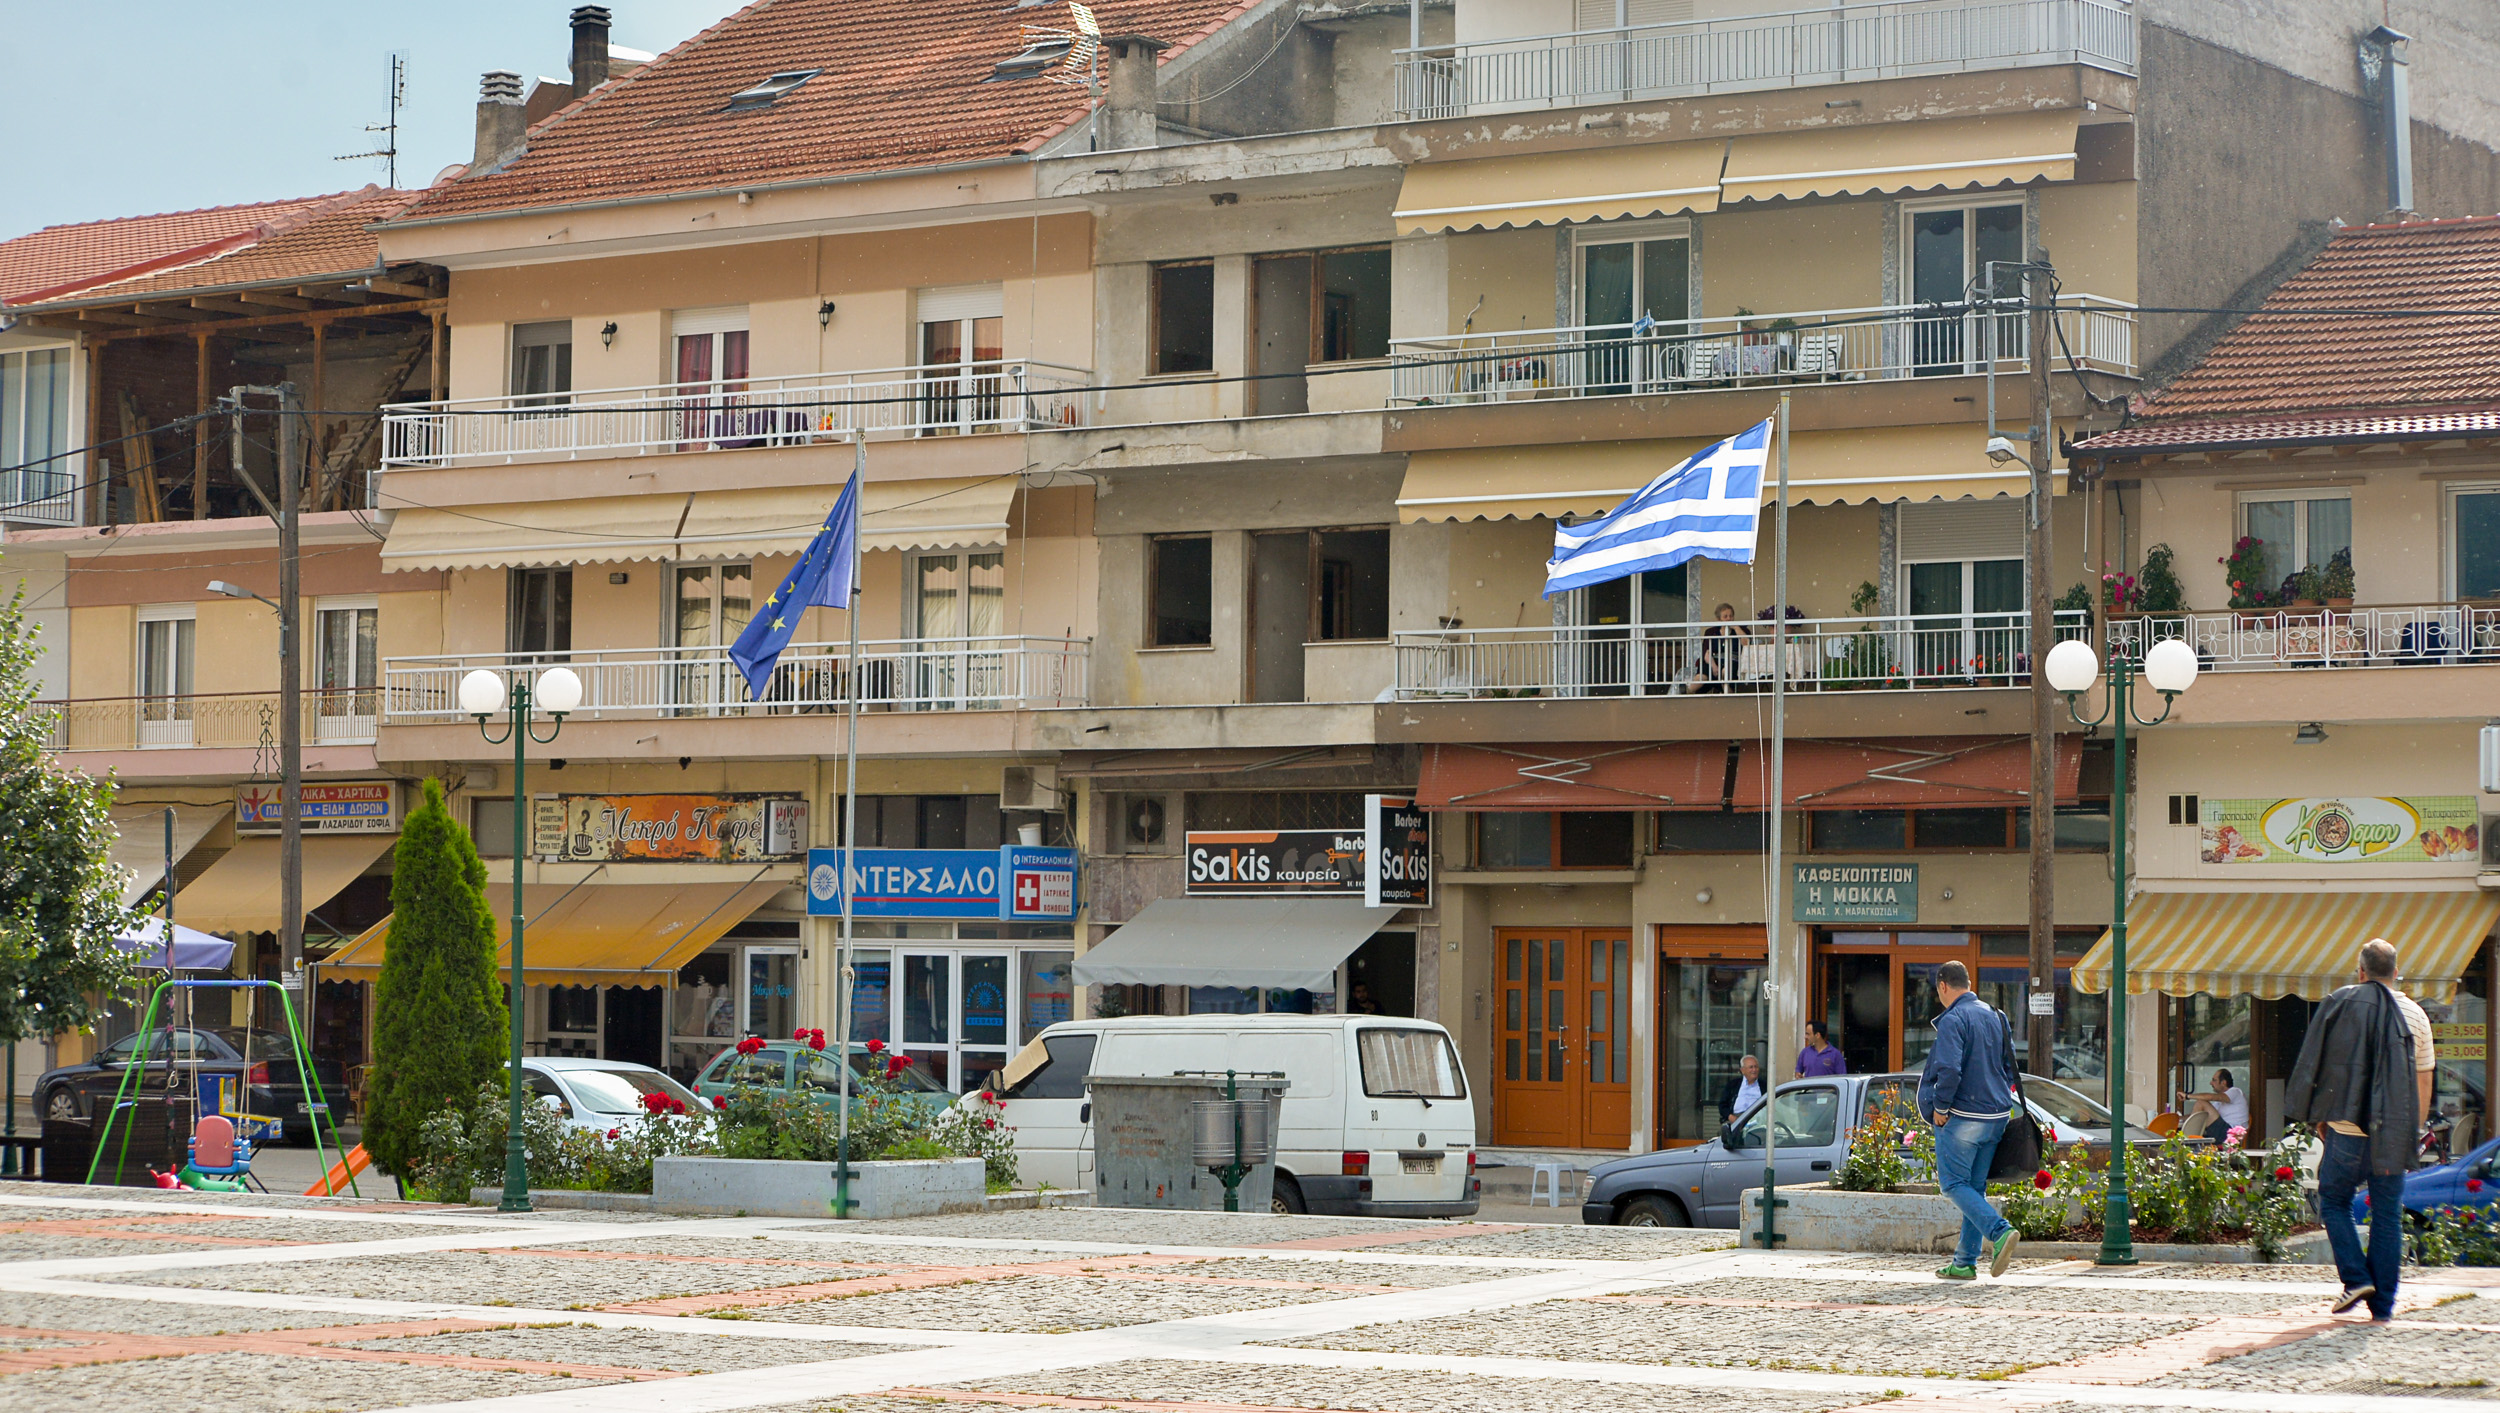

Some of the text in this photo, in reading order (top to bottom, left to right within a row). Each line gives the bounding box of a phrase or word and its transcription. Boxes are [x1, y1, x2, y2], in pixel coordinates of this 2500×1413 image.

[337, 787, 382, 799] ΧΑΡΤΙΚΑ
[265, 804, 313, 816] ΠΑΙΙΑ
[322, 803, 345, 815] ΕΙΔΗ
[349, 802, 383, 814] ΔΩΡΩΝ
[322, 818, 390, 829] ΛΑΖΑΡΙΔΟΥ ΣΟΦΙΑ
[1394, 813, 1422, 827] Barber
[594, 807, 680, 851] Μικρό
[1335, 836, 1365, 851] Barb
[1021, 855, 1073, 865] ΙΝΤΕΡΣΑΛΟΝΙΚΑ
[1191, 848, 1270, 882] Sakis
[1381, 847, 1428, 881] Sakis
[1043, 874, 1070, 882] ΚΕΝΤΡΟ
[1276, 868, 1340, 883] κουρείο
[1798, 868, 1914, 883] ΚΑΦΕΚΟΠΤΕΙΟΝ
[1043, 889, 1070, 898] ΙΑΤΡΙΚΗΣ
[1382, 889, 1411, 900] κουρείο
[1810, 887, 1898, 904] Η ΜΟΚΚΑ
[1845, 907, 1898, 916] ΜΑΡΑΓΚΟΖΙΔΗ
[2453, 1025, 2485, 1037] 3,50€
[2453, 1046, 2485, 1058] 3,00€
